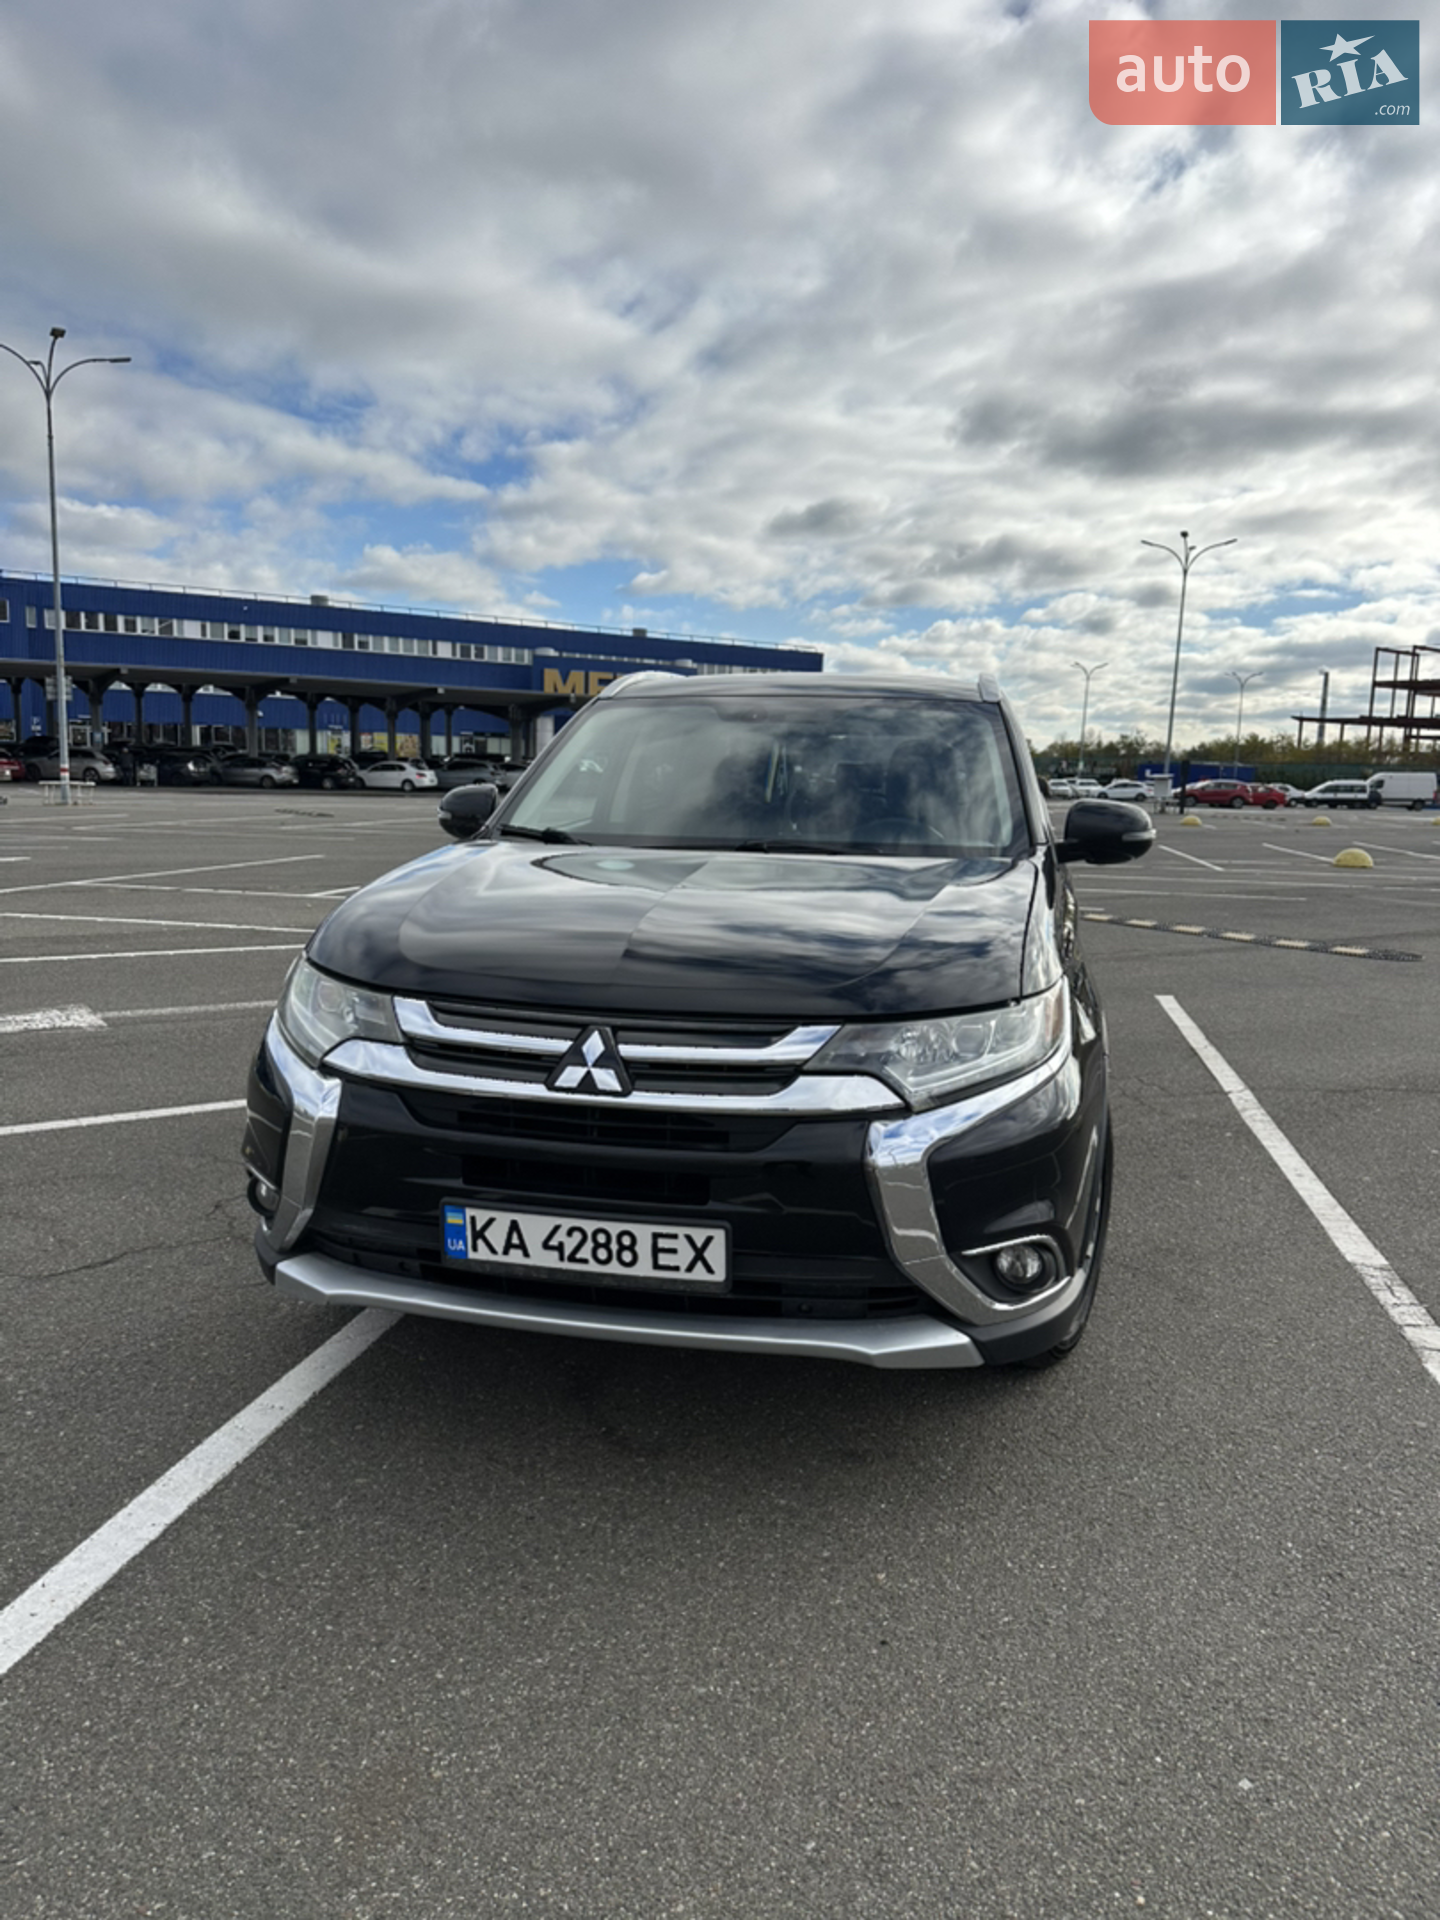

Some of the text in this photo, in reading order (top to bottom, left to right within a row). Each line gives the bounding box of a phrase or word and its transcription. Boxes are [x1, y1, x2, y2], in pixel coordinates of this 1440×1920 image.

[543, 668, 624, 697] ME
[447, 1238, 466, 1251] UA
[470, 1215, 716, 1276] KA 4288 EX
